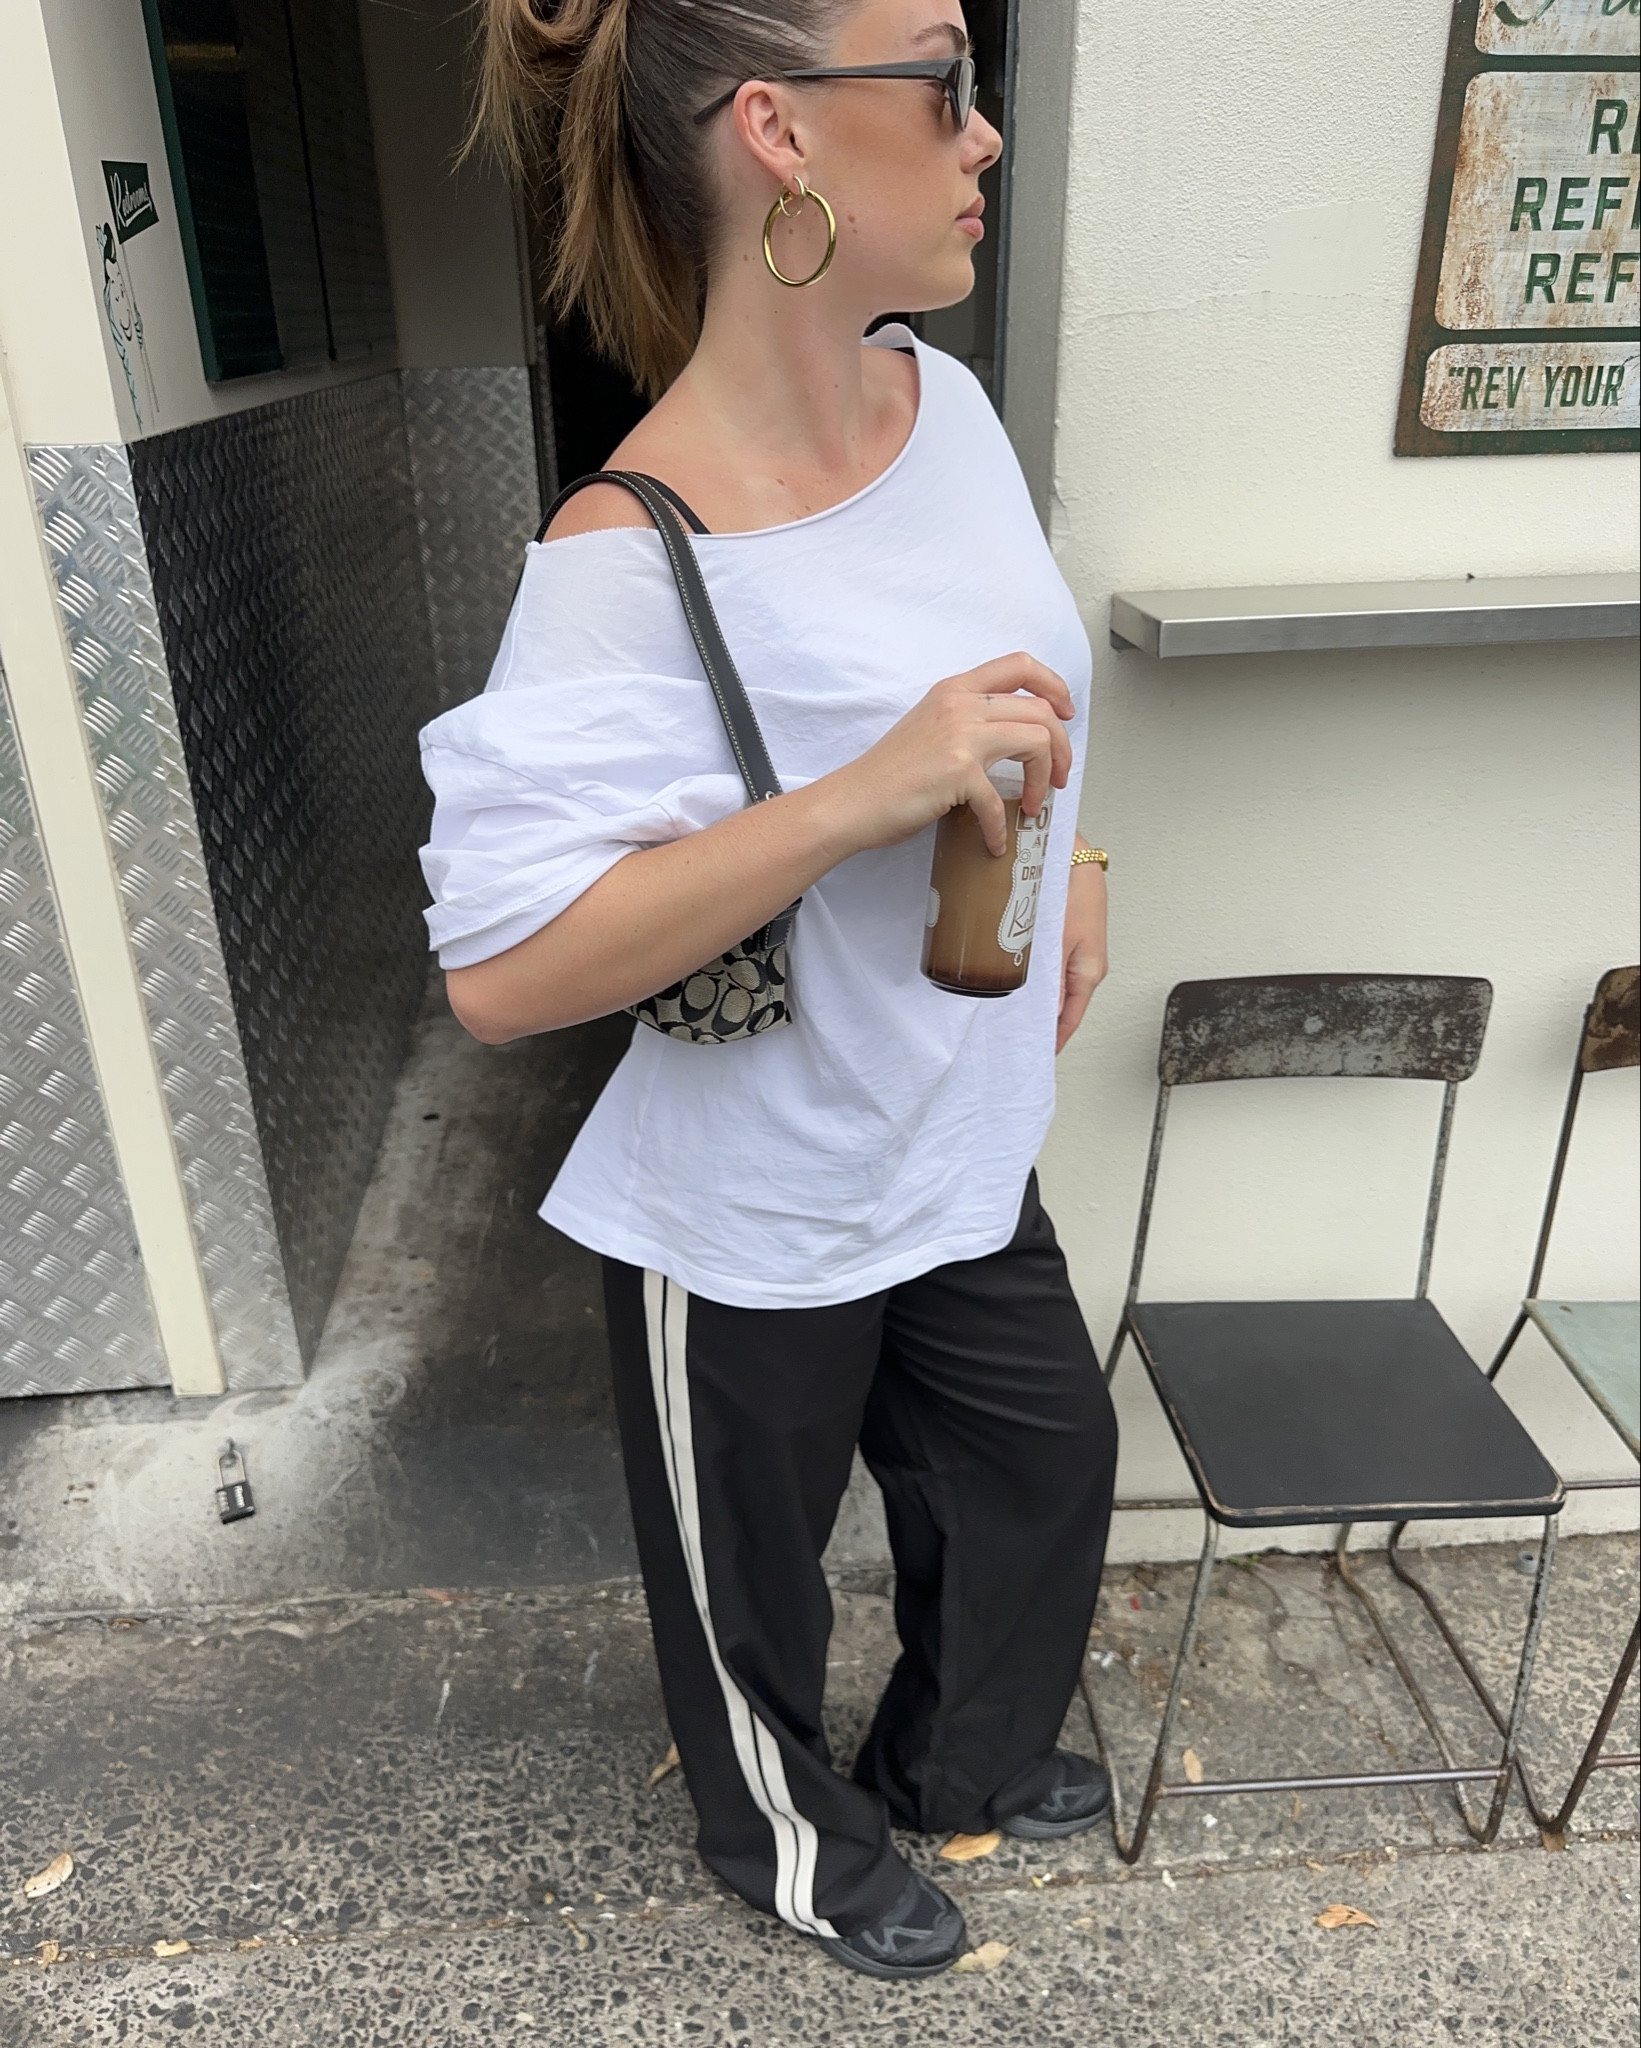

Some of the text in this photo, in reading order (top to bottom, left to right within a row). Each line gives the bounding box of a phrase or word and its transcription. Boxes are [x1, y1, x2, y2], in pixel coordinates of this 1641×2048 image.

[1588, 98, 1640, 154] R
[1509, 177, 1640, 231] REF
[1525, 252, 1640, 304] REF
[1544, 365, 1625, 407] YOUR
[1016, 805, 1052, 831] LO
